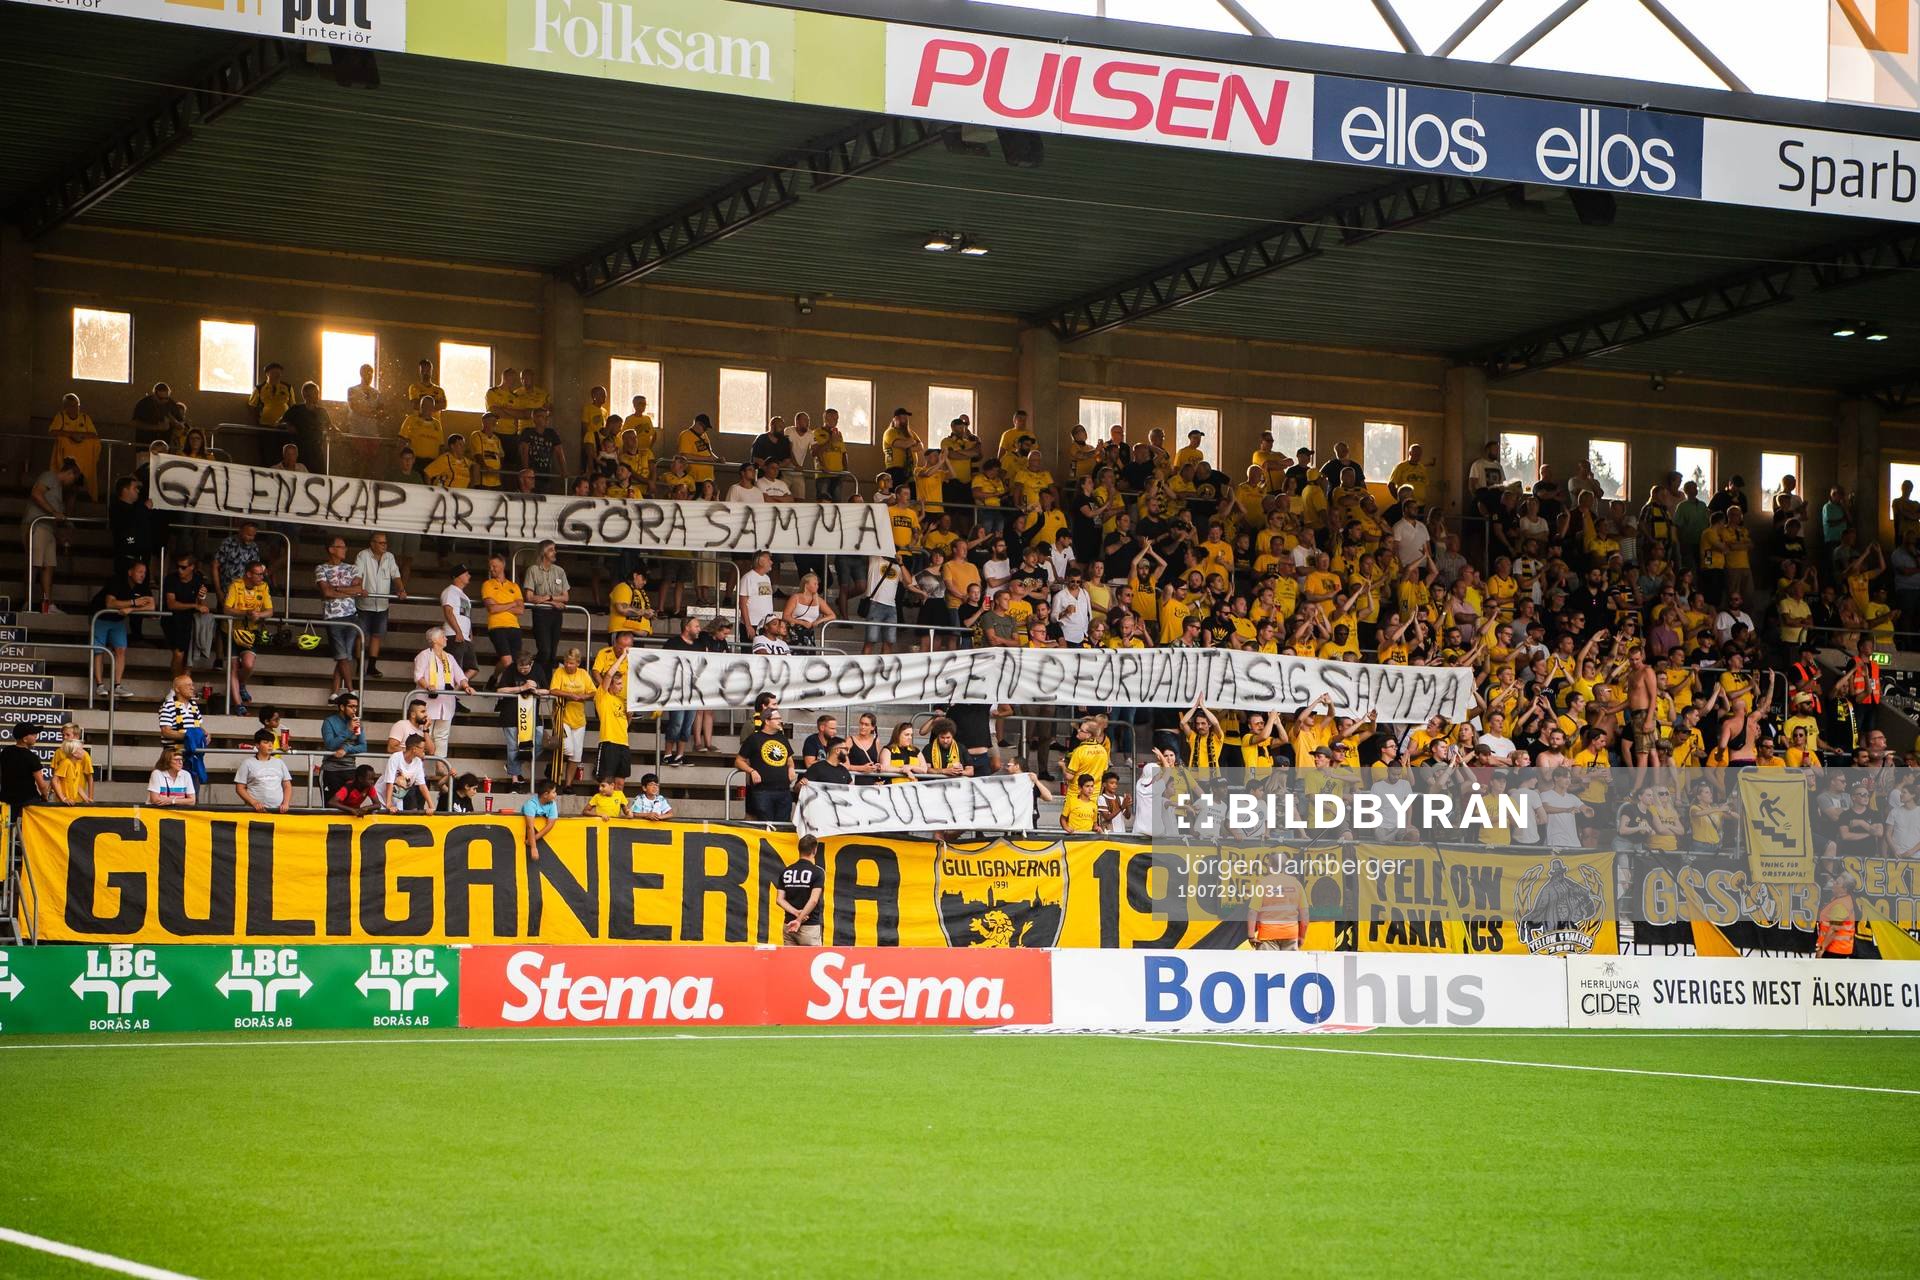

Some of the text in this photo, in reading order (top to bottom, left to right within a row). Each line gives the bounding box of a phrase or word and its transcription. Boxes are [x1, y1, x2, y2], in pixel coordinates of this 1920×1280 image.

[300, 24, 373, 44] interiör
[528, 0, 771, 81] Folksam
[911, 38, 1290, 146] PULSEN
[1341, 87, 1677, 192] ellos ellos
[1778, 140, 1917, 206] Sparb
[154, 461, 407, 526] GALENSKAP
[558, 500, 686, 546] GÖRA
[704, 503, 881, 549] SAMMA
[1320, 664, 1460, 720] SAMMA
[519, 707, 528, 732] 2012
[783, 869, 813, 884] SLO
[942, 858, 1061, 878] GULIGANERNA
[1367, 856, 1505, 911] YELLOW
[1368, 903, 1505, 954] FANAICS
[87, 949, 156, 977] LBC
[231, 949, 299, 977] LBC
[370, 948, 435, 976] LBC
[501, 950, 724, 1023] Stema.
[806, 951, 1015, 1022] Stema.
[1143, 955, 1486, 1026] Borohus
[1580, 978, 1639, 992] HERRLJUNGA
[1652, 979, 1746, 1005] SVERIGES
[1752, 980, 1801, 1006] MEST
[1812, 977, 1895, 1008] ÄLSKADE
[1581, 993, 1641, 1016] CIDER
[89, 1016, 150, 1031] BORÅS AB
[234, 1014, 293, 1029] BORÅS AB
[373, 1013, 429, 1027] BORÅS AB
